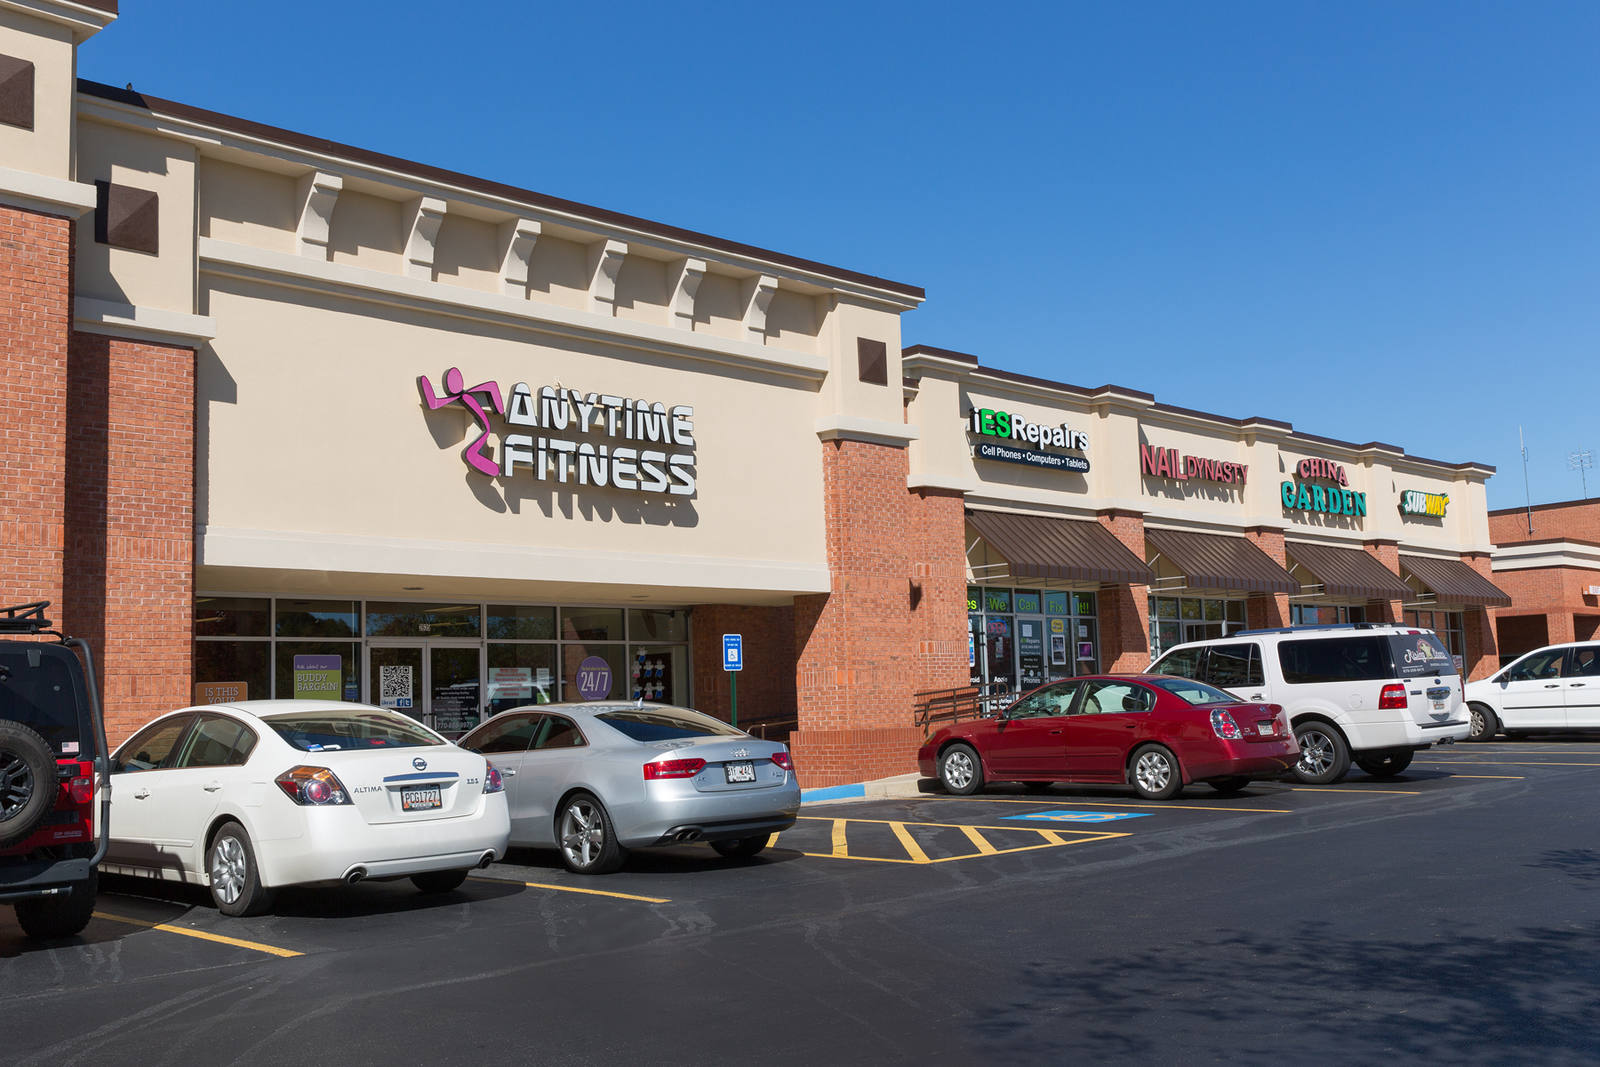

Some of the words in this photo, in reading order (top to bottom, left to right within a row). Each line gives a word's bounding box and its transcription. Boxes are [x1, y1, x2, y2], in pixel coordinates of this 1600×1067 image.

[505, 382, 694, 447] ANYTIME
[973, 407, 1090, 451] iESRepairs
[504, 434, 695, 495] FITNESS
[981, 445, 996, 457] Cell
[996, 447, 1022, 461] Phones
[1026, 451, 1062, 466] Computers
[1065, 457, 1088, 471] Tablets
[1141, 443, 1188, 481] NAIL
[1187, 456, 1249, 486] DYNASTY
[1300, 458, 1349, 487] CHINA
[1281, 480, 1367, 517] GARDEN
[1404, 489, 1450, 517] SUBWAY
[967, 599, 977, 610] es
[988, 597, 1007, 611] We
[1018, 598, 1037, 611] Can
[1049, 601, 1064, 614] Fix
[205, 687, 214, 697] IS
[215, 686, 239, 697] THIS
[297, 673, 328, 682] BUDDY
[581, 671, 609, 692] 24/7
[353, 785, 383, 793] ALTIMA
